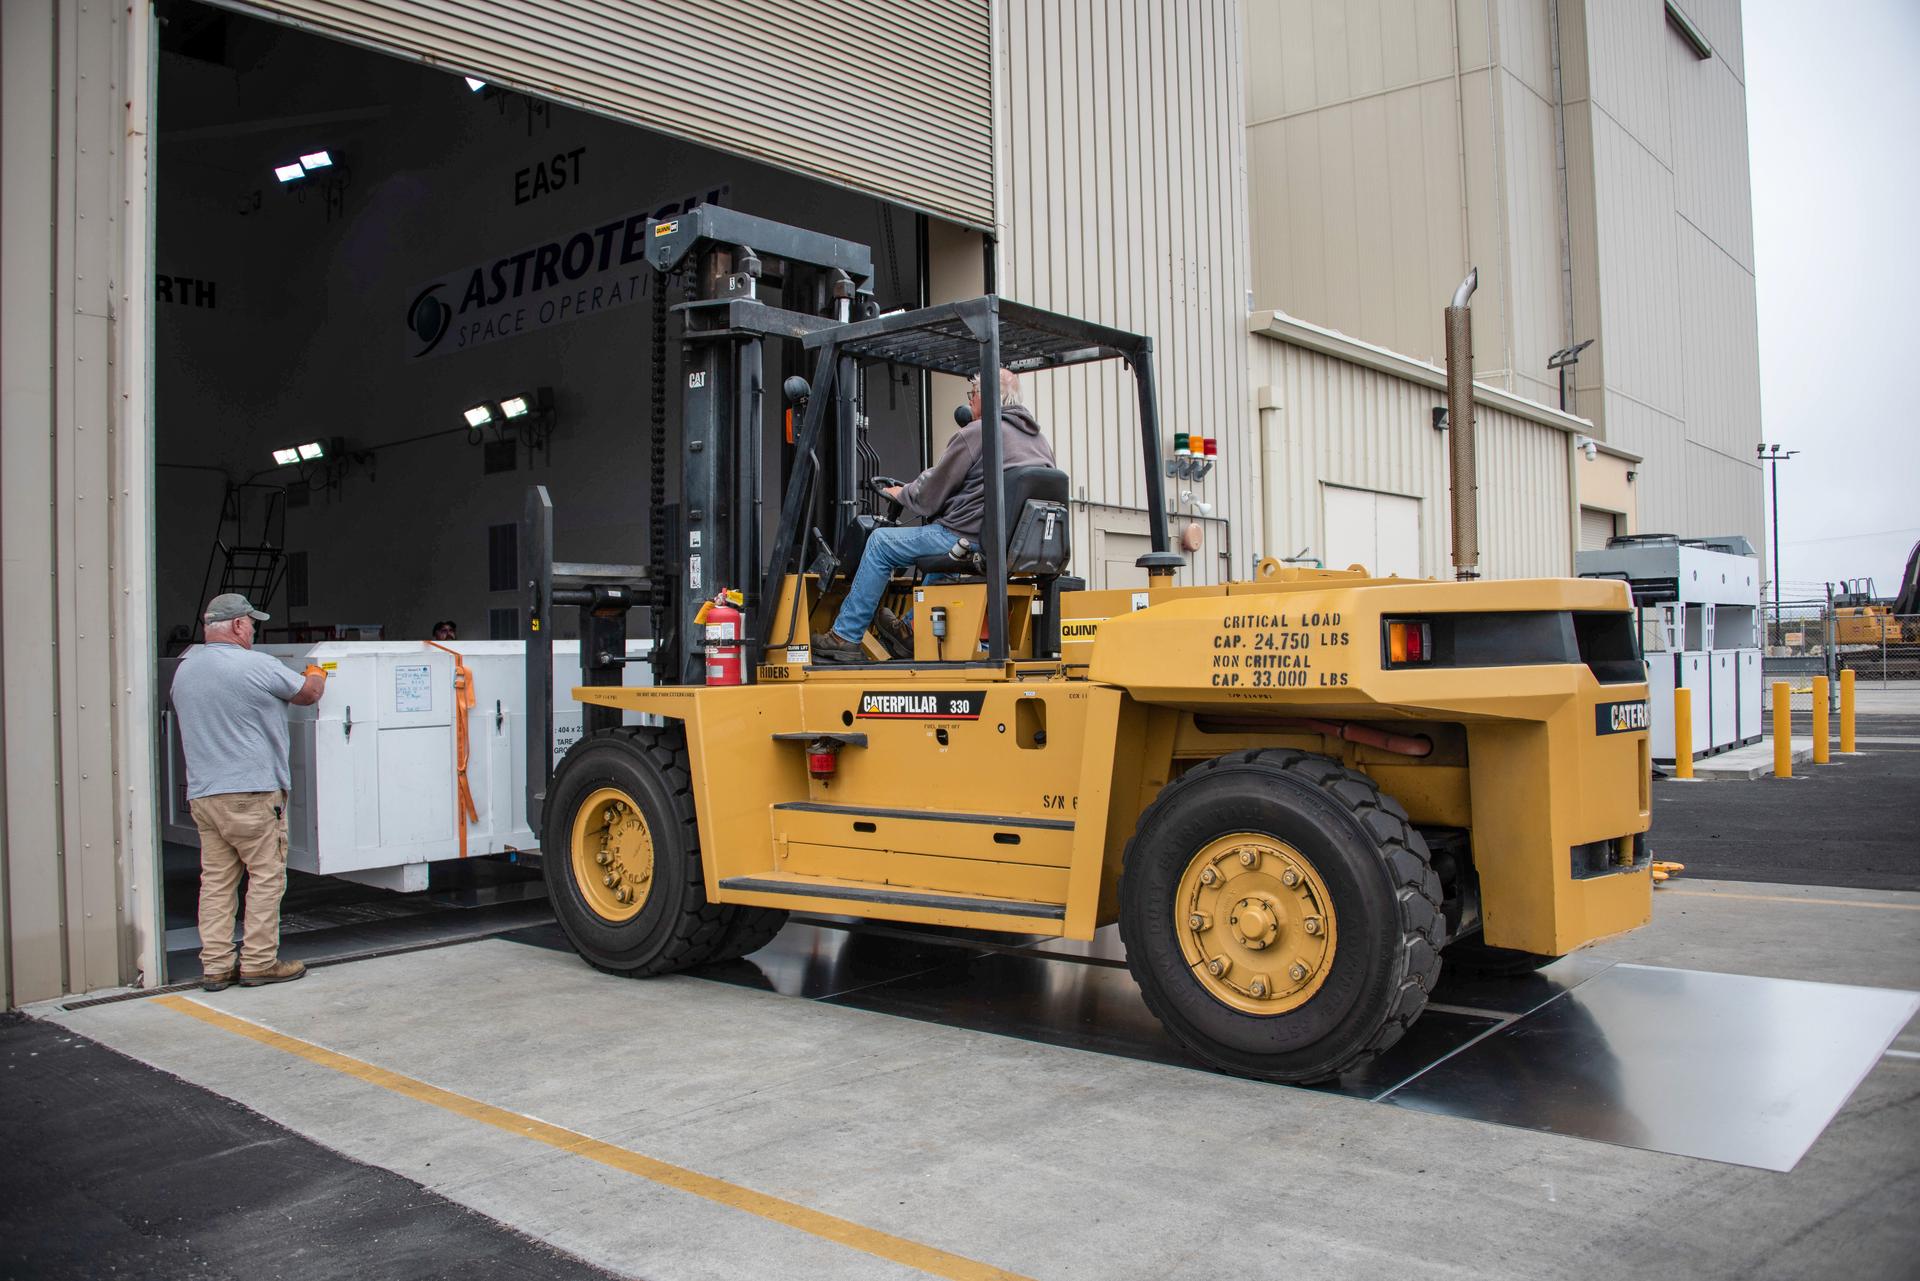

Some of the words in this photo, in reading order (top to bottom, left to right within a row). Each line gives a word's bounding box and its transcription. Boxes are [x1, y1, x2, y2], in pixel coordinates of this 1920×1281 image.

[515, 147, 586, 206] EAST
[458, 309, 526, 348] SPACE
[689, 372, 706, 388] CAT
[1224, 614, 1288, 629] CRITICAL
[1301, 613, 1341, 627] LOAD
[1214, 635, 1246, 649] CAP.
[1321, 632, 1350, 646] LBS
[1213, 655, 1239, 668] NON
[1245, 655, 1311, 668] CRITICAL
[760, 666, 789, 679] RIDERS
[1212, 673, 1244, 687] CAP.
[1320, 673, 1348, 686] LBS
[863, 695, 937, 714] CATERPILLAR
[950, 700, 970, 714] 330
[557, 738, 573, 746] TARE
[1043, 794, 1065, 809] S/N
